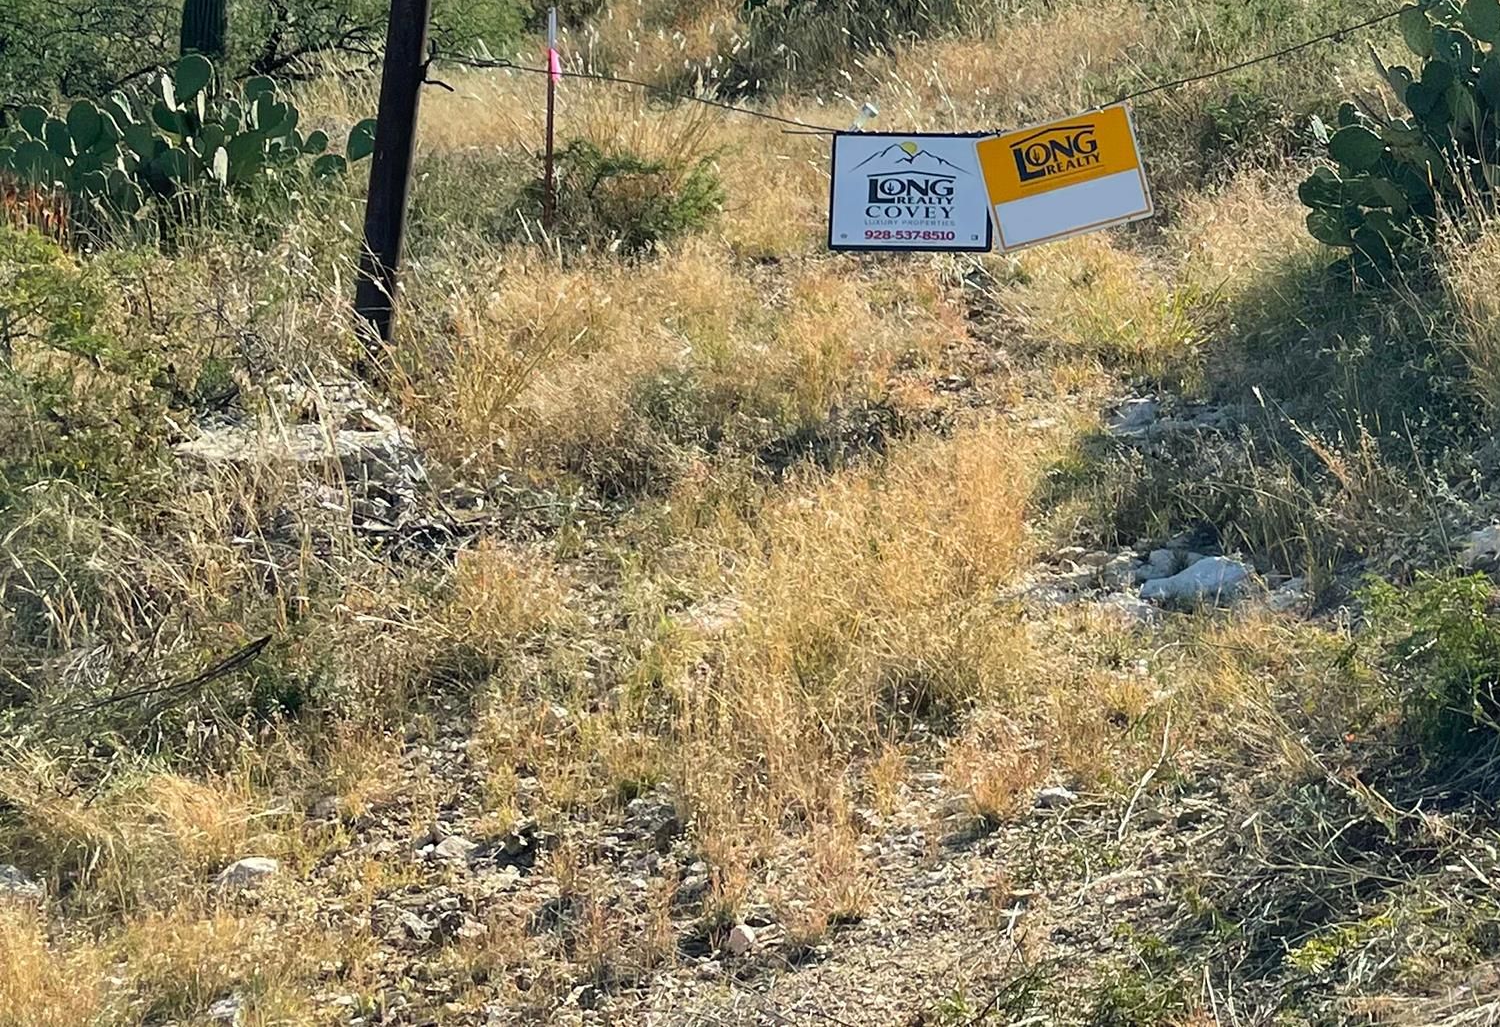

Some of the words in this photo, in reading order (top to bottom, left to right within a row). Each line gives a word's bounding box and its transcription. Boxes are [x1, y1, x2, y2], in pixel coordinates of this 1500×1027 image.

[1012, 130, 1098, 182] LONG
[1045, 152, 1100, 175] REALTY
[868, 178, 954, 203] LONG
[896, 196, 954, 205] REALTY
[865, 205, 955, 219] COVEY
[864, 229, 955, 241] 928-537-8510
